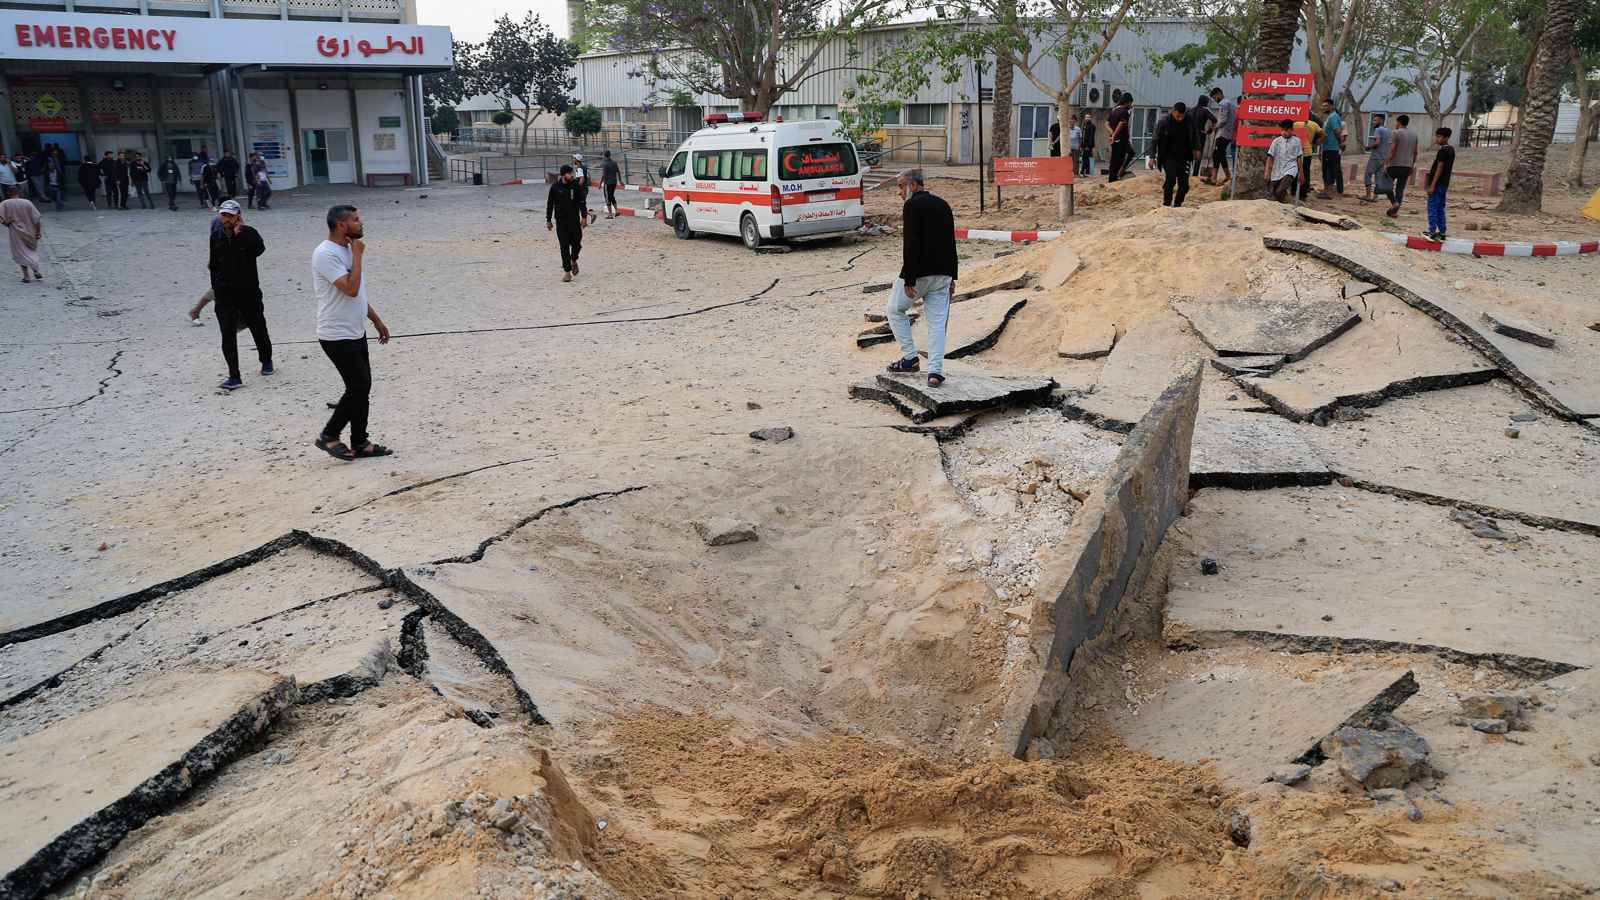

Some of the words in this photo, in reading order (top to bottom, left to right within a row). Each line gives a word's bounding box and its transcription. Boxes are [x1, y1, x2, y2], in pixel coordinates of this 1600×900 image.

[15, 24, 176, 51] EMERGENCY
[1248, 105, 1302, 115] EMERGENCY
[799, 163, 845, 174] AMBULANCE
[782, 183, 803, 192] M.O.H
